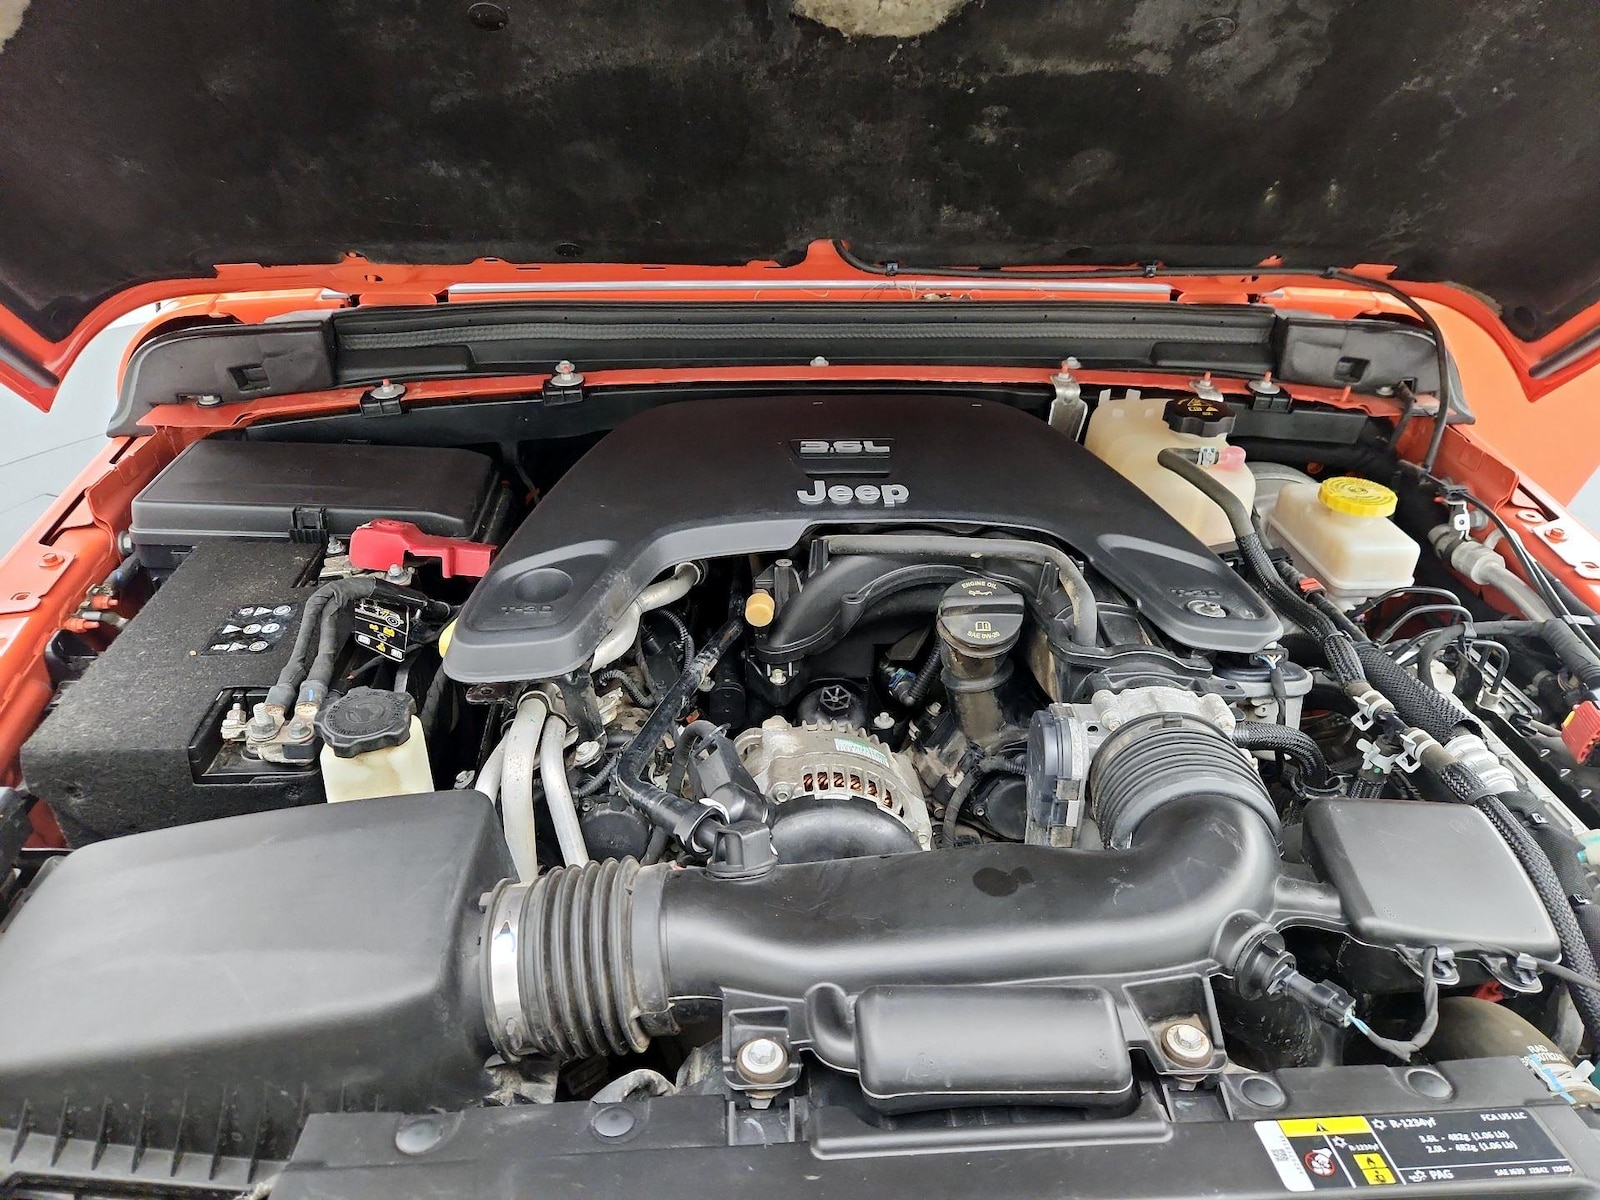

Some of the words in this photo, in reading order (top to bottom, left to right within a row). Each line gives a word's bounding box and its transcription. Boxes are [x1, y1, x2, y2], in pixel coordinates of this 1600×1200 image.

[800, 440, 890, 453] 3.6L
[796, 480, 909, 507] Jeep
[961, 581, 986, 589] ENGINE
[987, 582, 998, 590] OIL
[1526, 1044, 1548, 1053] RAD
[1480, 1114, 1499, 1122] FCA
[1499, 1113, 1511, 1121] US
[1511, 1112, 1528, 1120] LLC
[1389, 1117, 1436, 1129] R-1234yf
[1418, 1134, 1440, 1143] 3.6L
[1447, 1133, 1472, 1142] 482g
[1425, 1145, 1446, 1153] 2.0L
[1455, 1143, 1479, 1152] 482g
[1429, 1169, 1454, 1180] PAG
[1494, 1168, 1509, 1176] SAE
